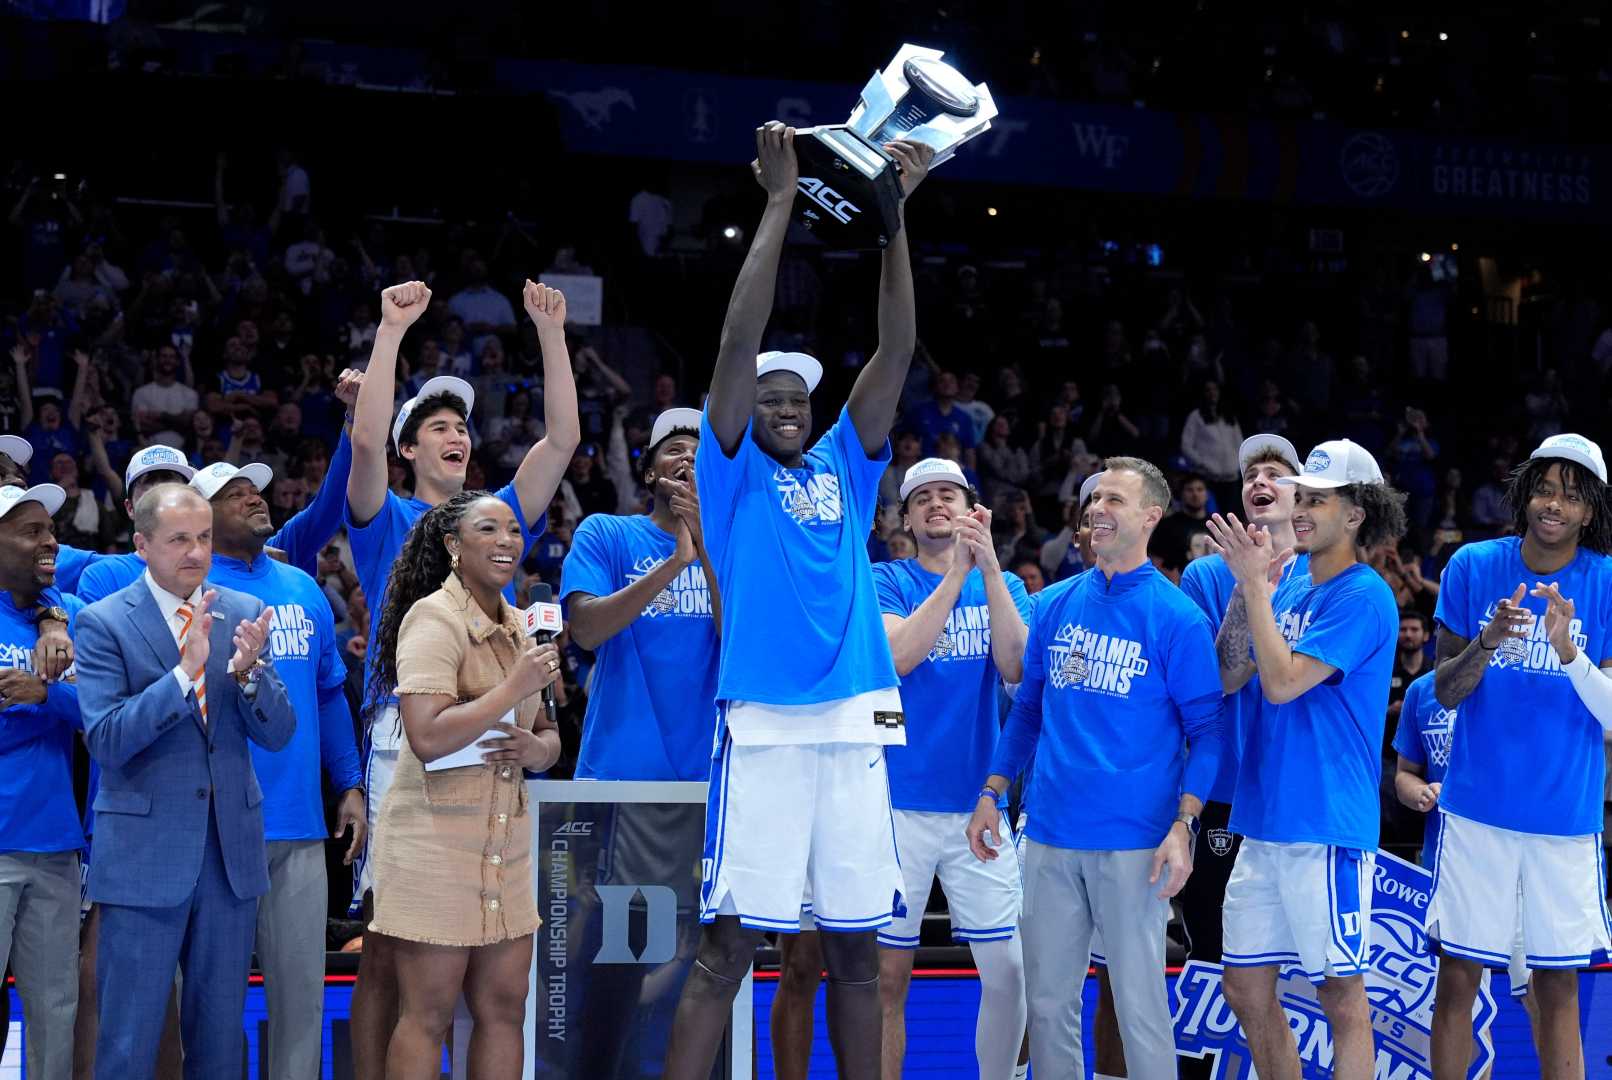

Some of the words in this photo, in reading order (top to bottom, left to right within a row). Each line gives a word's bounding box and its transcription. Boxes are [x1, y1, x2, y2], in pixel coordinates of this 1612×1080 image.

[797, 177, 862, 224] ACC
[1433, 164, 1591, 204] GREATNESS
[268, 604, 305, 630] AMP
[269, 629, 309, 657] ONS
[1069, 629, 1142, 670] CHAMP
[1083, 658, 1135, 695] IONS
[552, 821, 595, 835] ACC
[549, 839, 568, 968] CHAMPIONSHIP
[592, 885, 677, 964] D
[547, 972, 567, 1042] TROPHY
